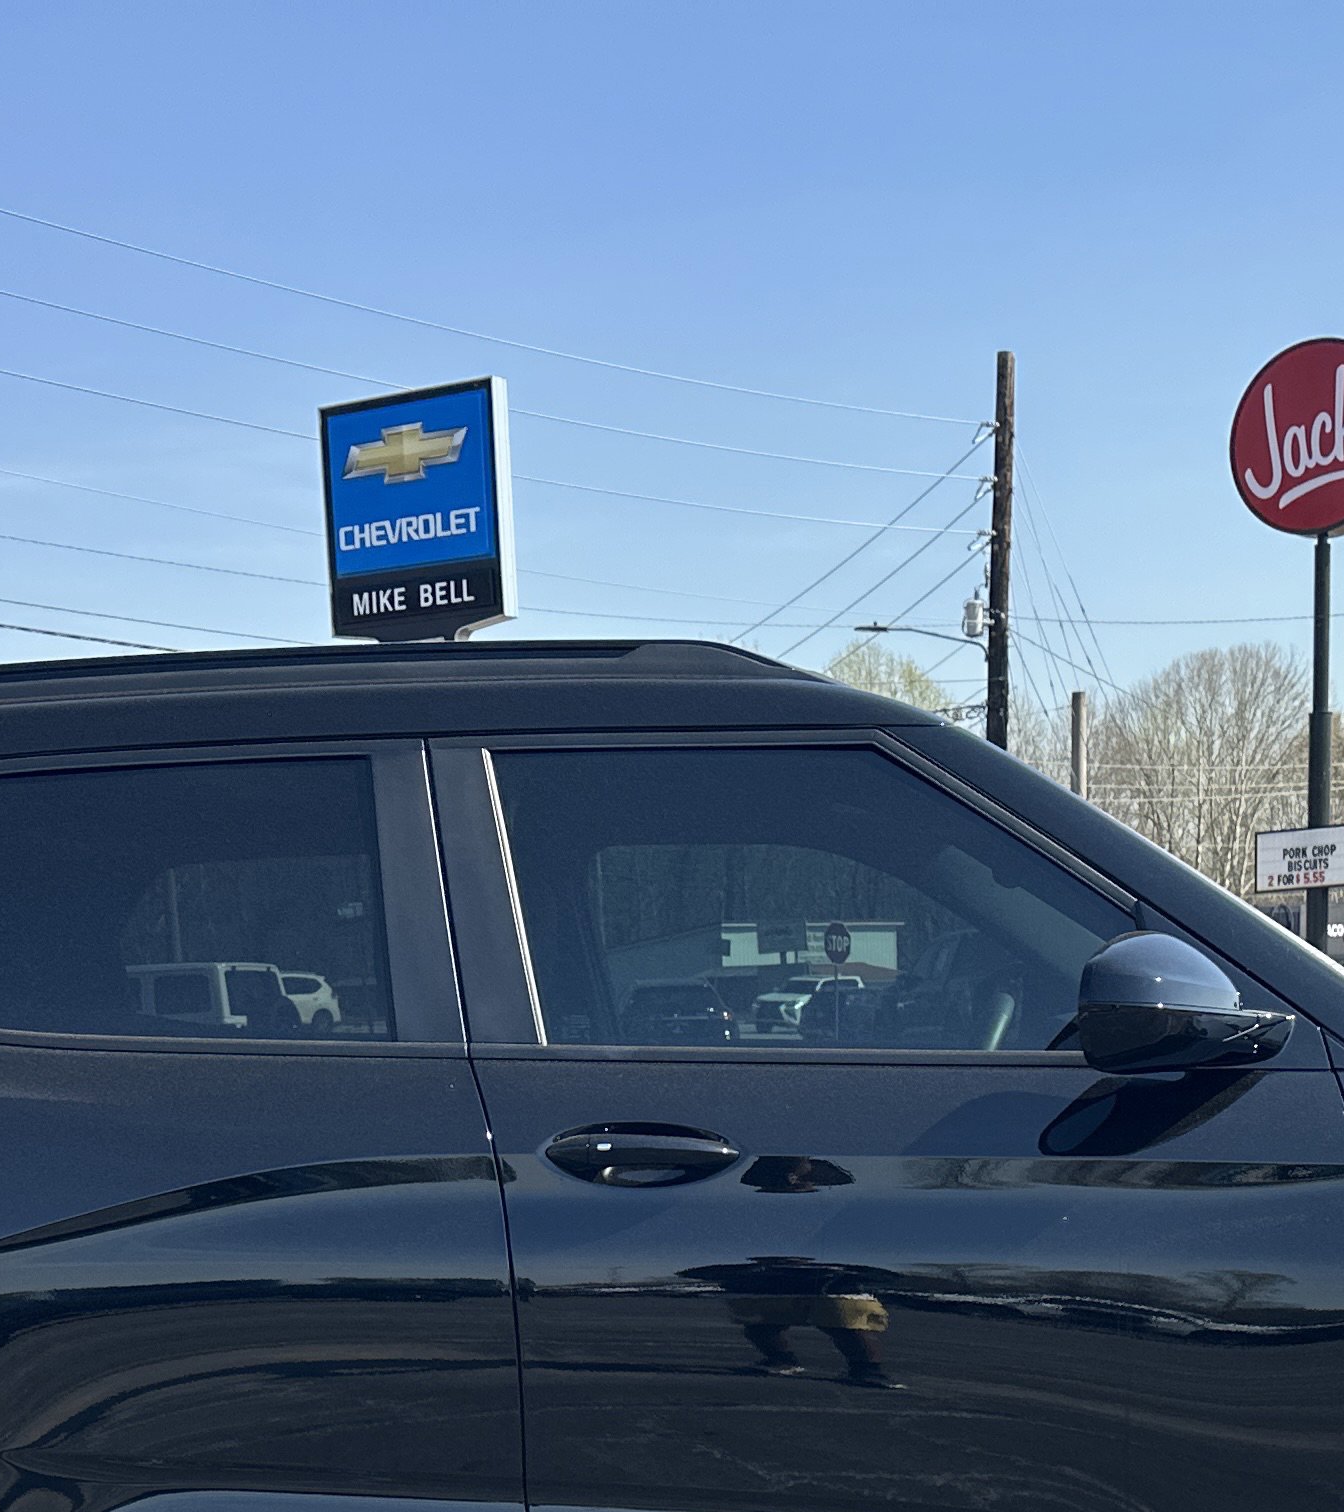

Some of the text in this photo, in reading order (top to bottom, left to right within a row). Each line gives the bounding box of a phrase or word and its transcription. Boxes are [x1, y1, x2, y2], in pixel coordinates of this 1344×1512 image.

[339, 506, 480, 551] CHEVROLET
[353, 578, 476, 616] MIKE BELL
[1282, 843, 1337, 860] PORK CHOP
[1287, 857, 1329, 872] BISCUITS
[1267, 875, 1275, 887] 2
[1277, 873, 1295, 886] FOR
[827, 935, 850, 952] STOP
